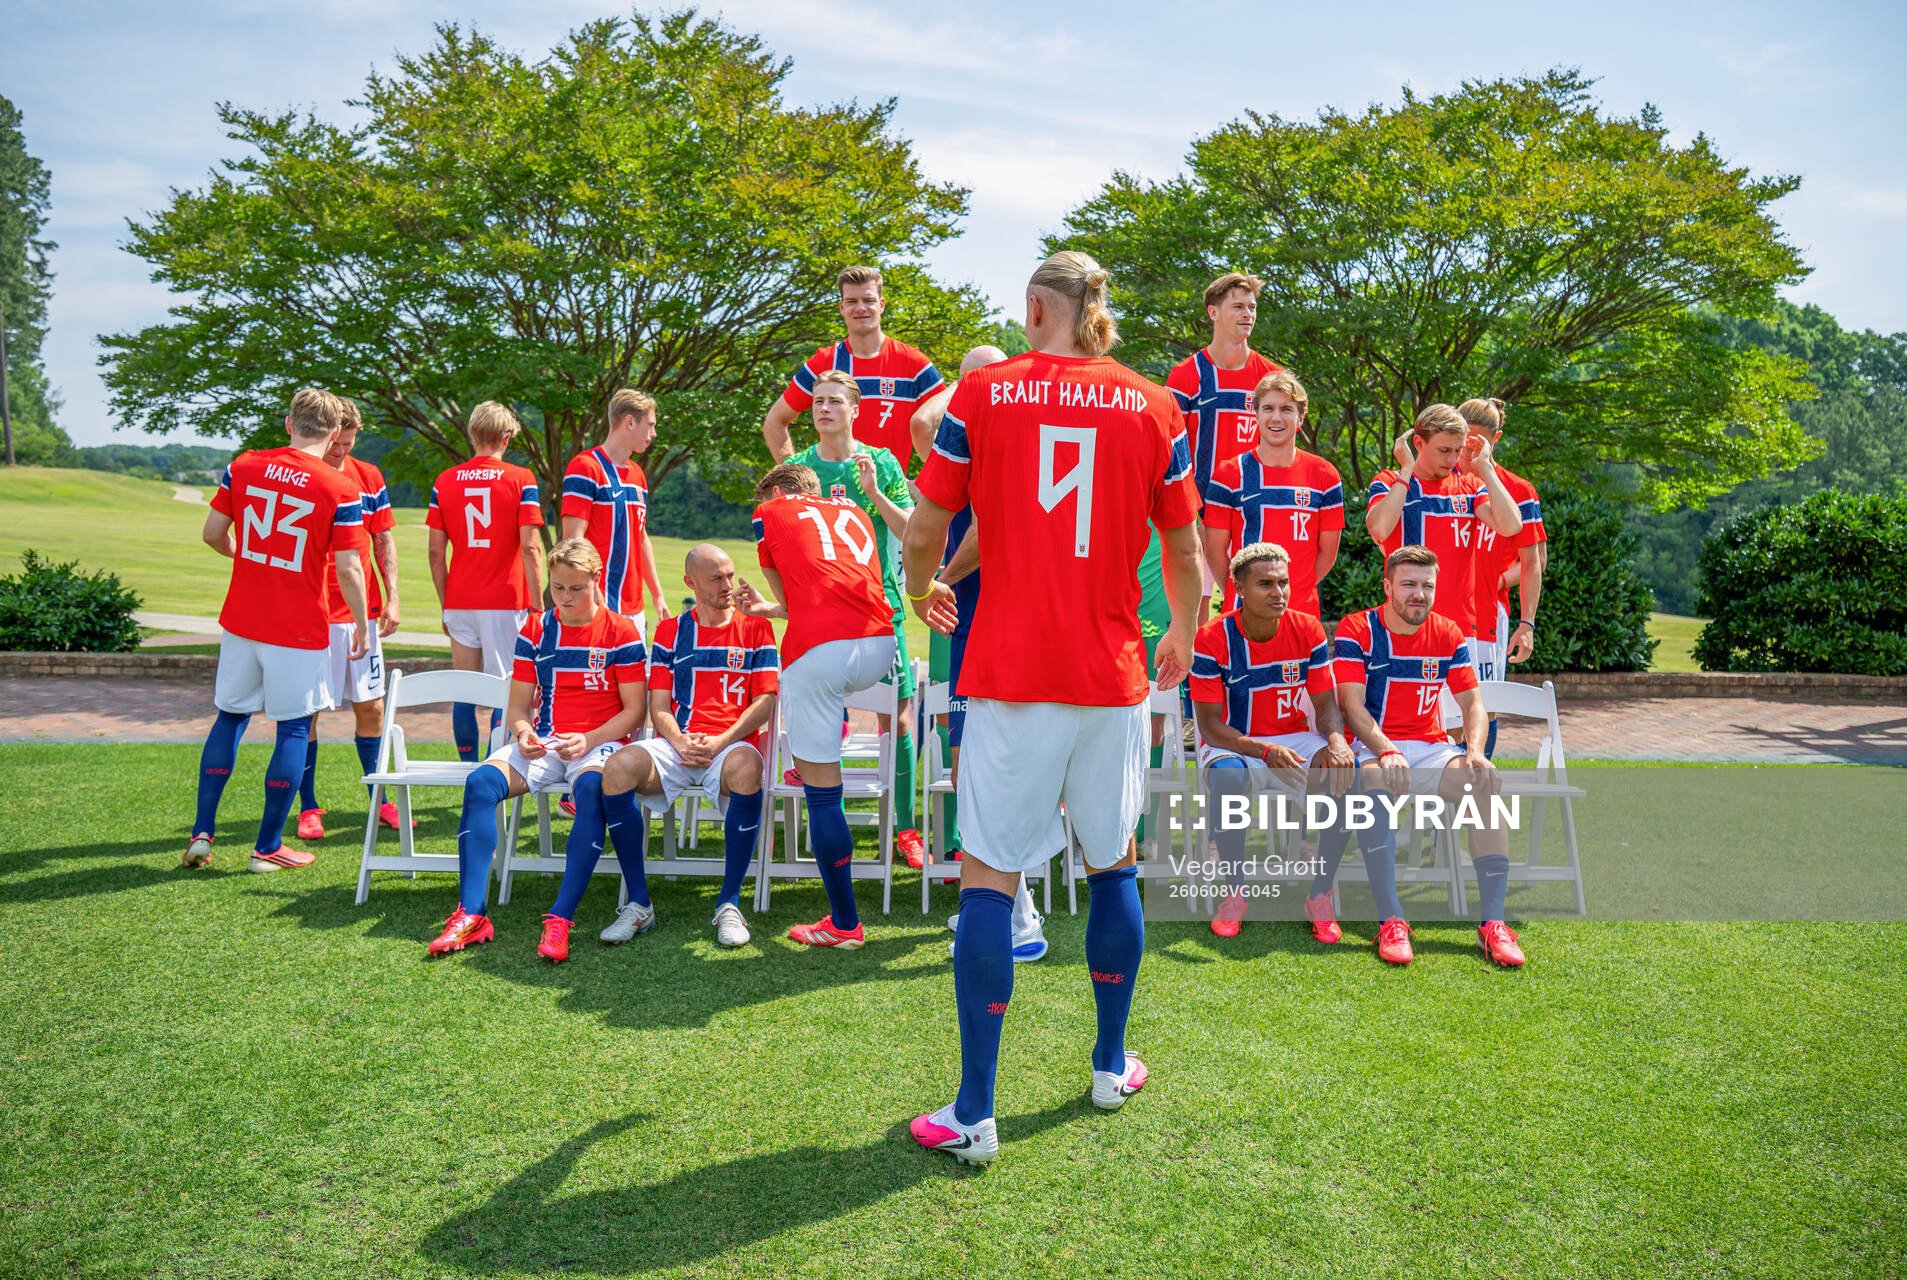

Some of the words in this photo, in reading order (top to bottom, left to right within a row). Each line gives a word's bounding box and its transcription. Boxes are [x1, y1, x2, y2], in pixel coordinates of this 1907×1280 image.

[990, 380, 1052, 406] BRAUT
[1059, 381, 1148, 413] HAALAND
[878, 401, 895, 429] 7
[264, 463, 311, 488] HAUGE
[1038, 423, 1097, 559] 9
[241, 484, 316, 573] 23
[464, 487, 492, 549] 2
[1290, 511, 1312, 541] 18
[1450, 518, 1472, 549] 16
[797, 505, 875, 567] 10
[369, 655, 381, 680] 5
[583, 670, 609, 691] 21
[719, 673, 746, 706] 14
[1416, 685, 1440, 716] 15
